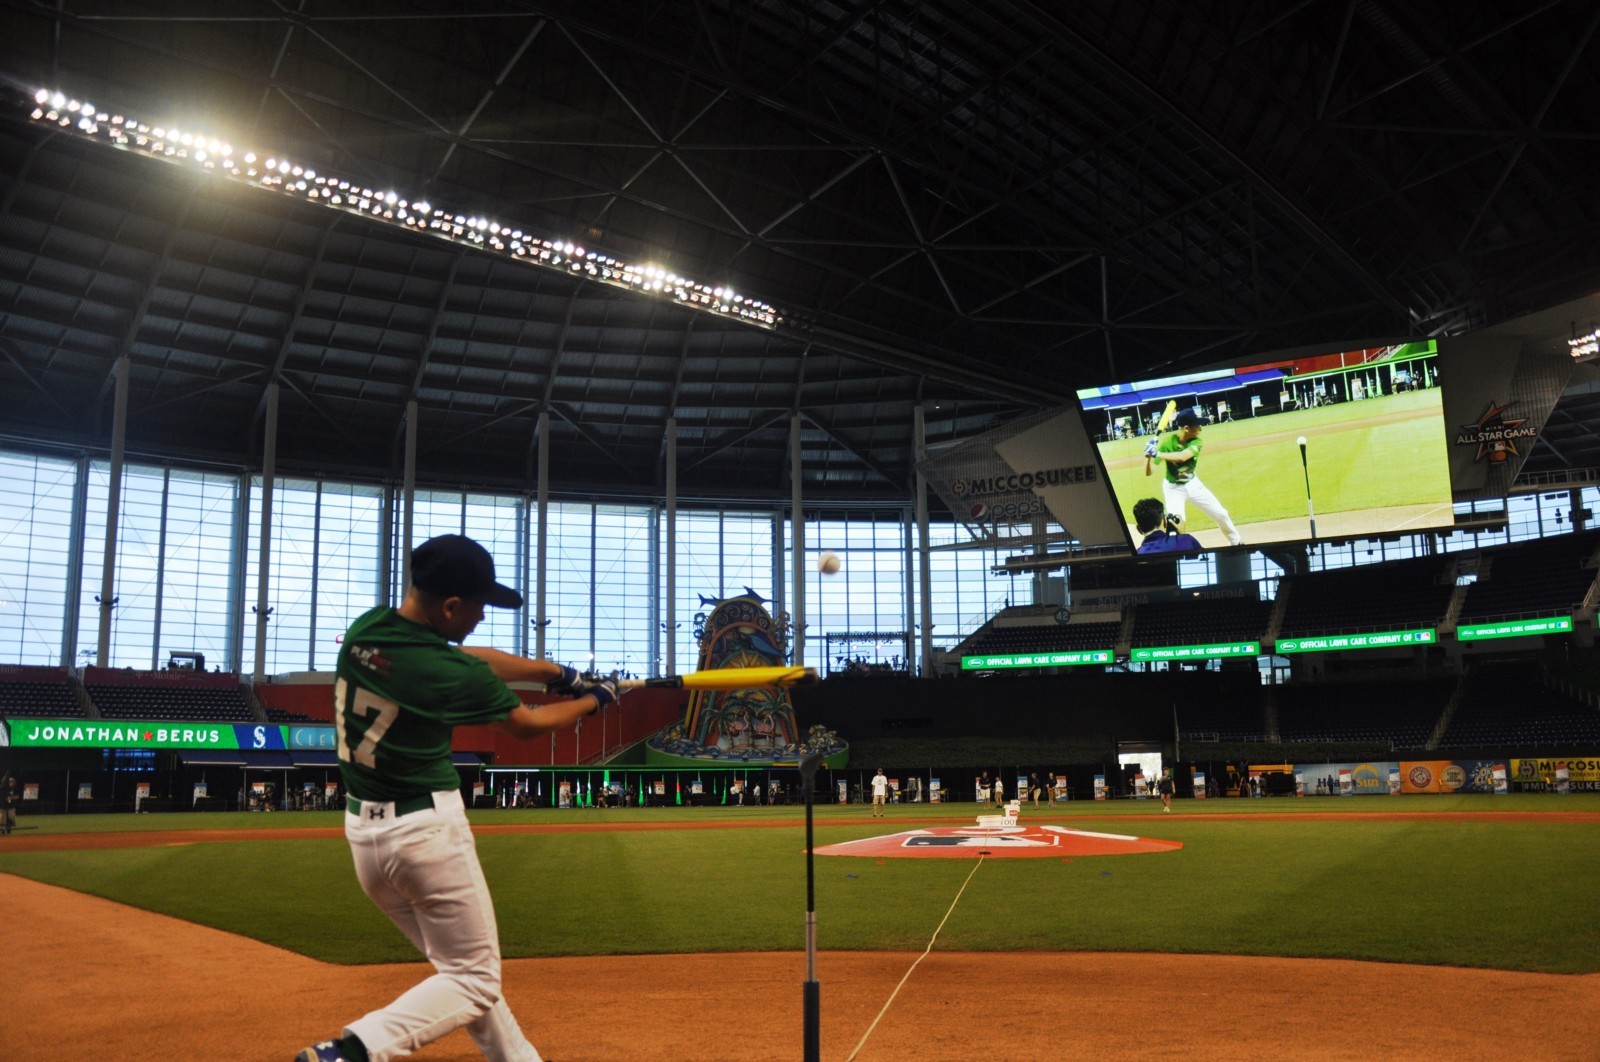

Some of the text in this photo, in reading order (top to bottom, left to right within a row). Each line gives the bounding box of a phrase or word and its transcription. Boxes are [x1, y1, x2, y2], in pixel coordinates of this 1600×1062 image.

[1457, 427, 1537, 444] ALL STAR GAME
[970, 465, 1095, 494] MICCOSUKEE
[990, 497, 1045, 519] pepsi
[1056, 611, 1068, 620] 42
[1300, 640, 1327, 649] OFFICIAL
[1330, 639, 1348, 647] LAWN
[1350, 637, 1366, 646] CARE
[1369, 635, 1401, 644] COMPANY
[987, 657, 1012, 666] OFFICIAL
[1015, 656, 1032, 664] LAWN
[1034, 655, 1049, 663] CARE
[1051, 654, 1080, 663] COMPANY
[335, 677, 400, 769] 17
[28, 726, 220, 743] JONATHAN BERUS
